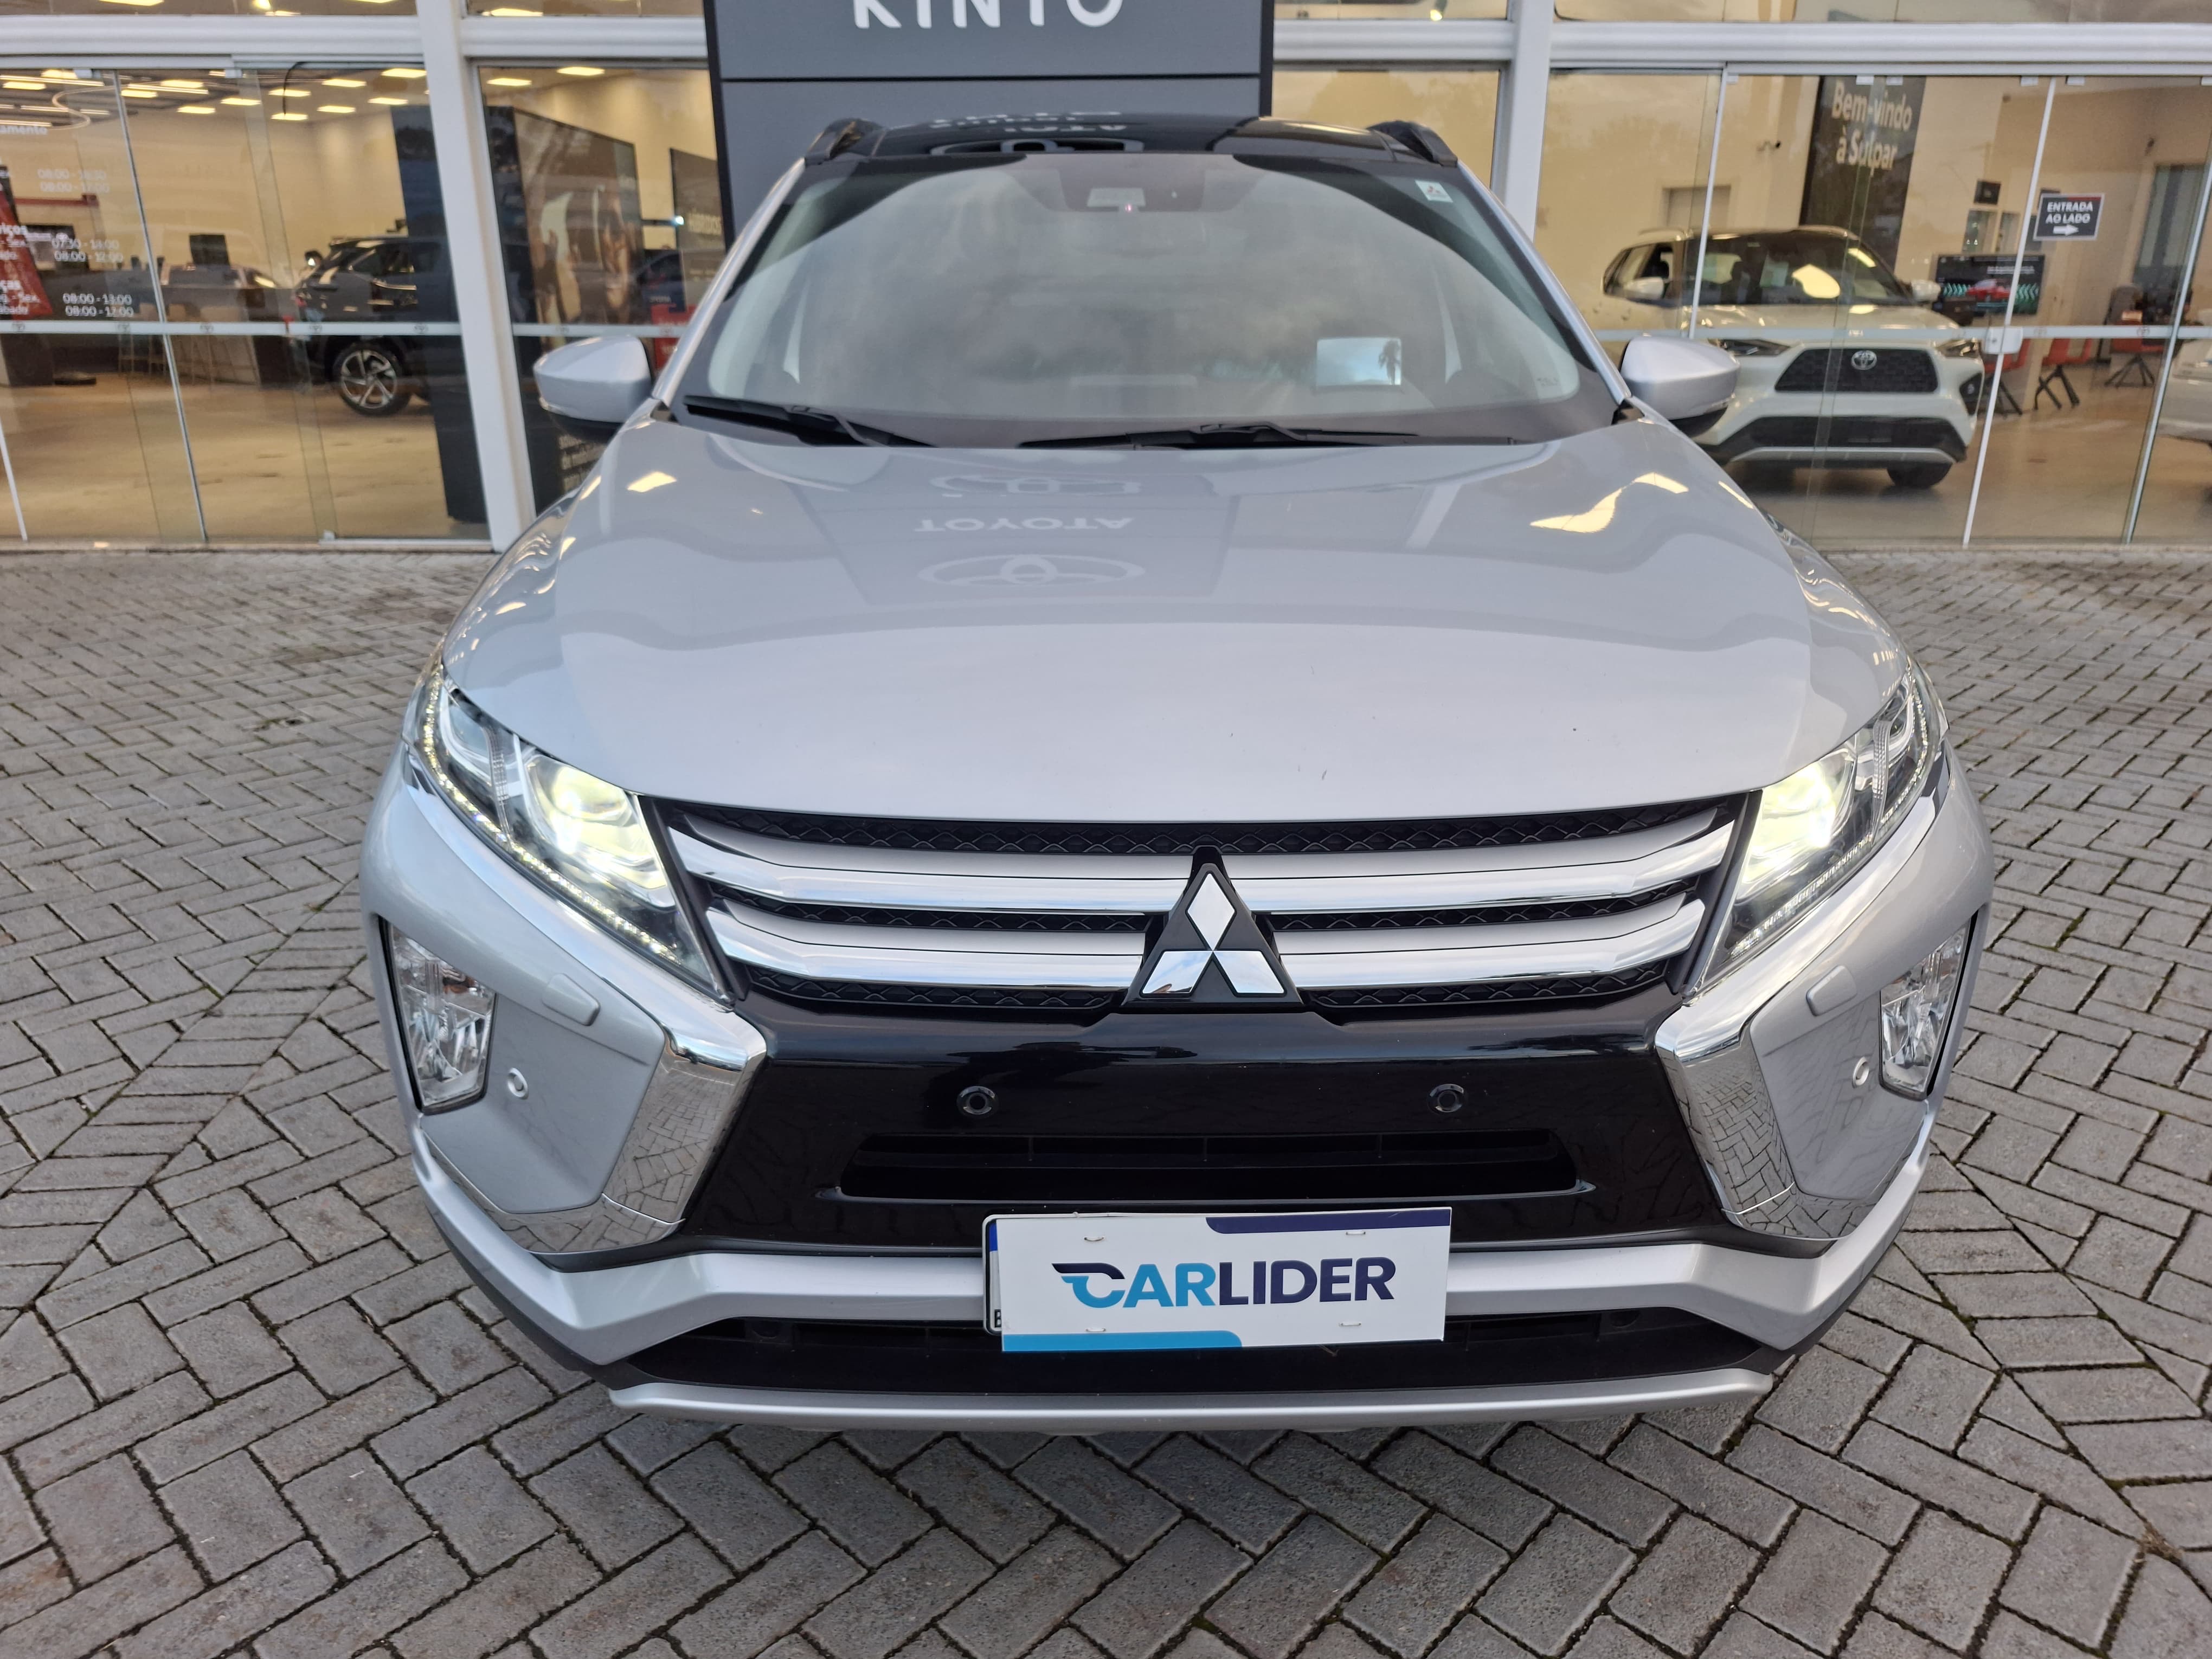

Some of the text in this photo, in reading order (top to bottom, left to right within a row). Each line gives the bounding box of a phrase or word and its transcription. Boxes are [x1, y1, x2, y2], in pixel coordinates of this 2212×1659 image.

[1848, 129, 1898, 178] Sulpar
[2047, 201, 2093, 212] ENTRADA
[2046, 213, 2091, 223] AO LADO
[54, 250, 86, 261] 08:00
[63, 293, 94, 304] 08:00
[65, 306, 97, 317] 08:00
[1051, 1256, 1396, 1308] CARLIDER
